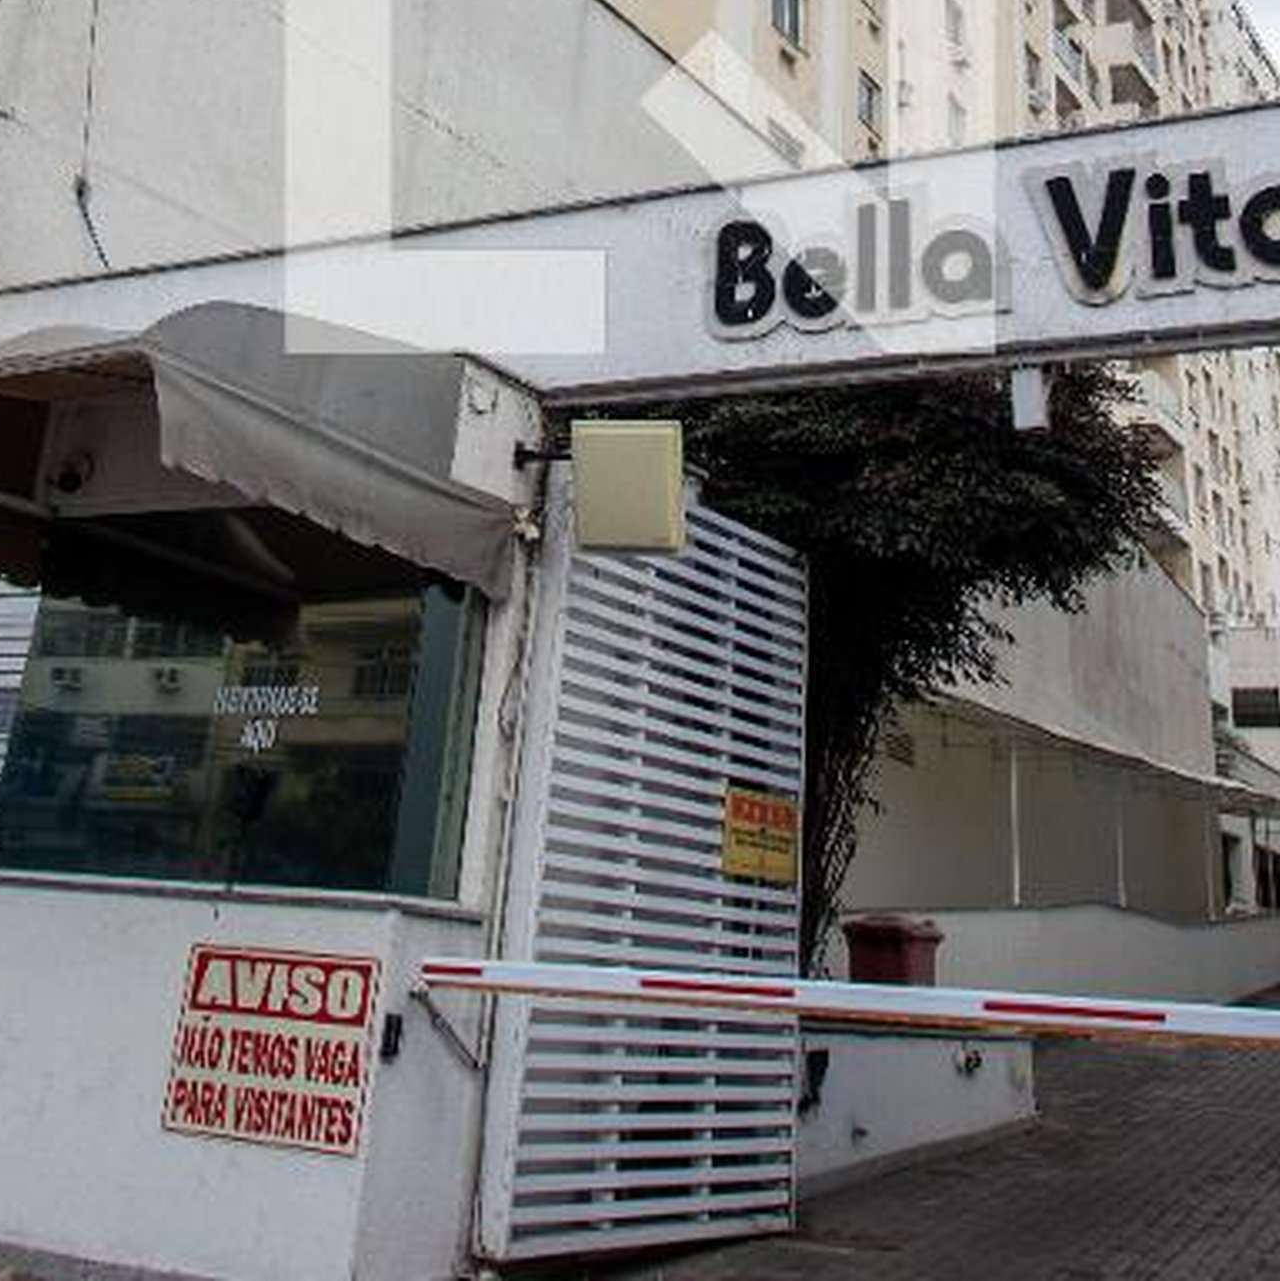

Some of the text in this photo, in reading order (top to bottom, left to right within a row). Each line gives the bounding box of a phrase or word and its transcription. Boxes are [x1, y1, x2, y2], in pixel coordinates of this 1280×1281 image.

[715, 199, 993, 326] Bella
[195, 959, 365, 1019] AVISO
[178, 1016, 360, 1087] NÃO TEMOS VAGA
[172, 1077, 355, 1145] PARA VISITANTES
